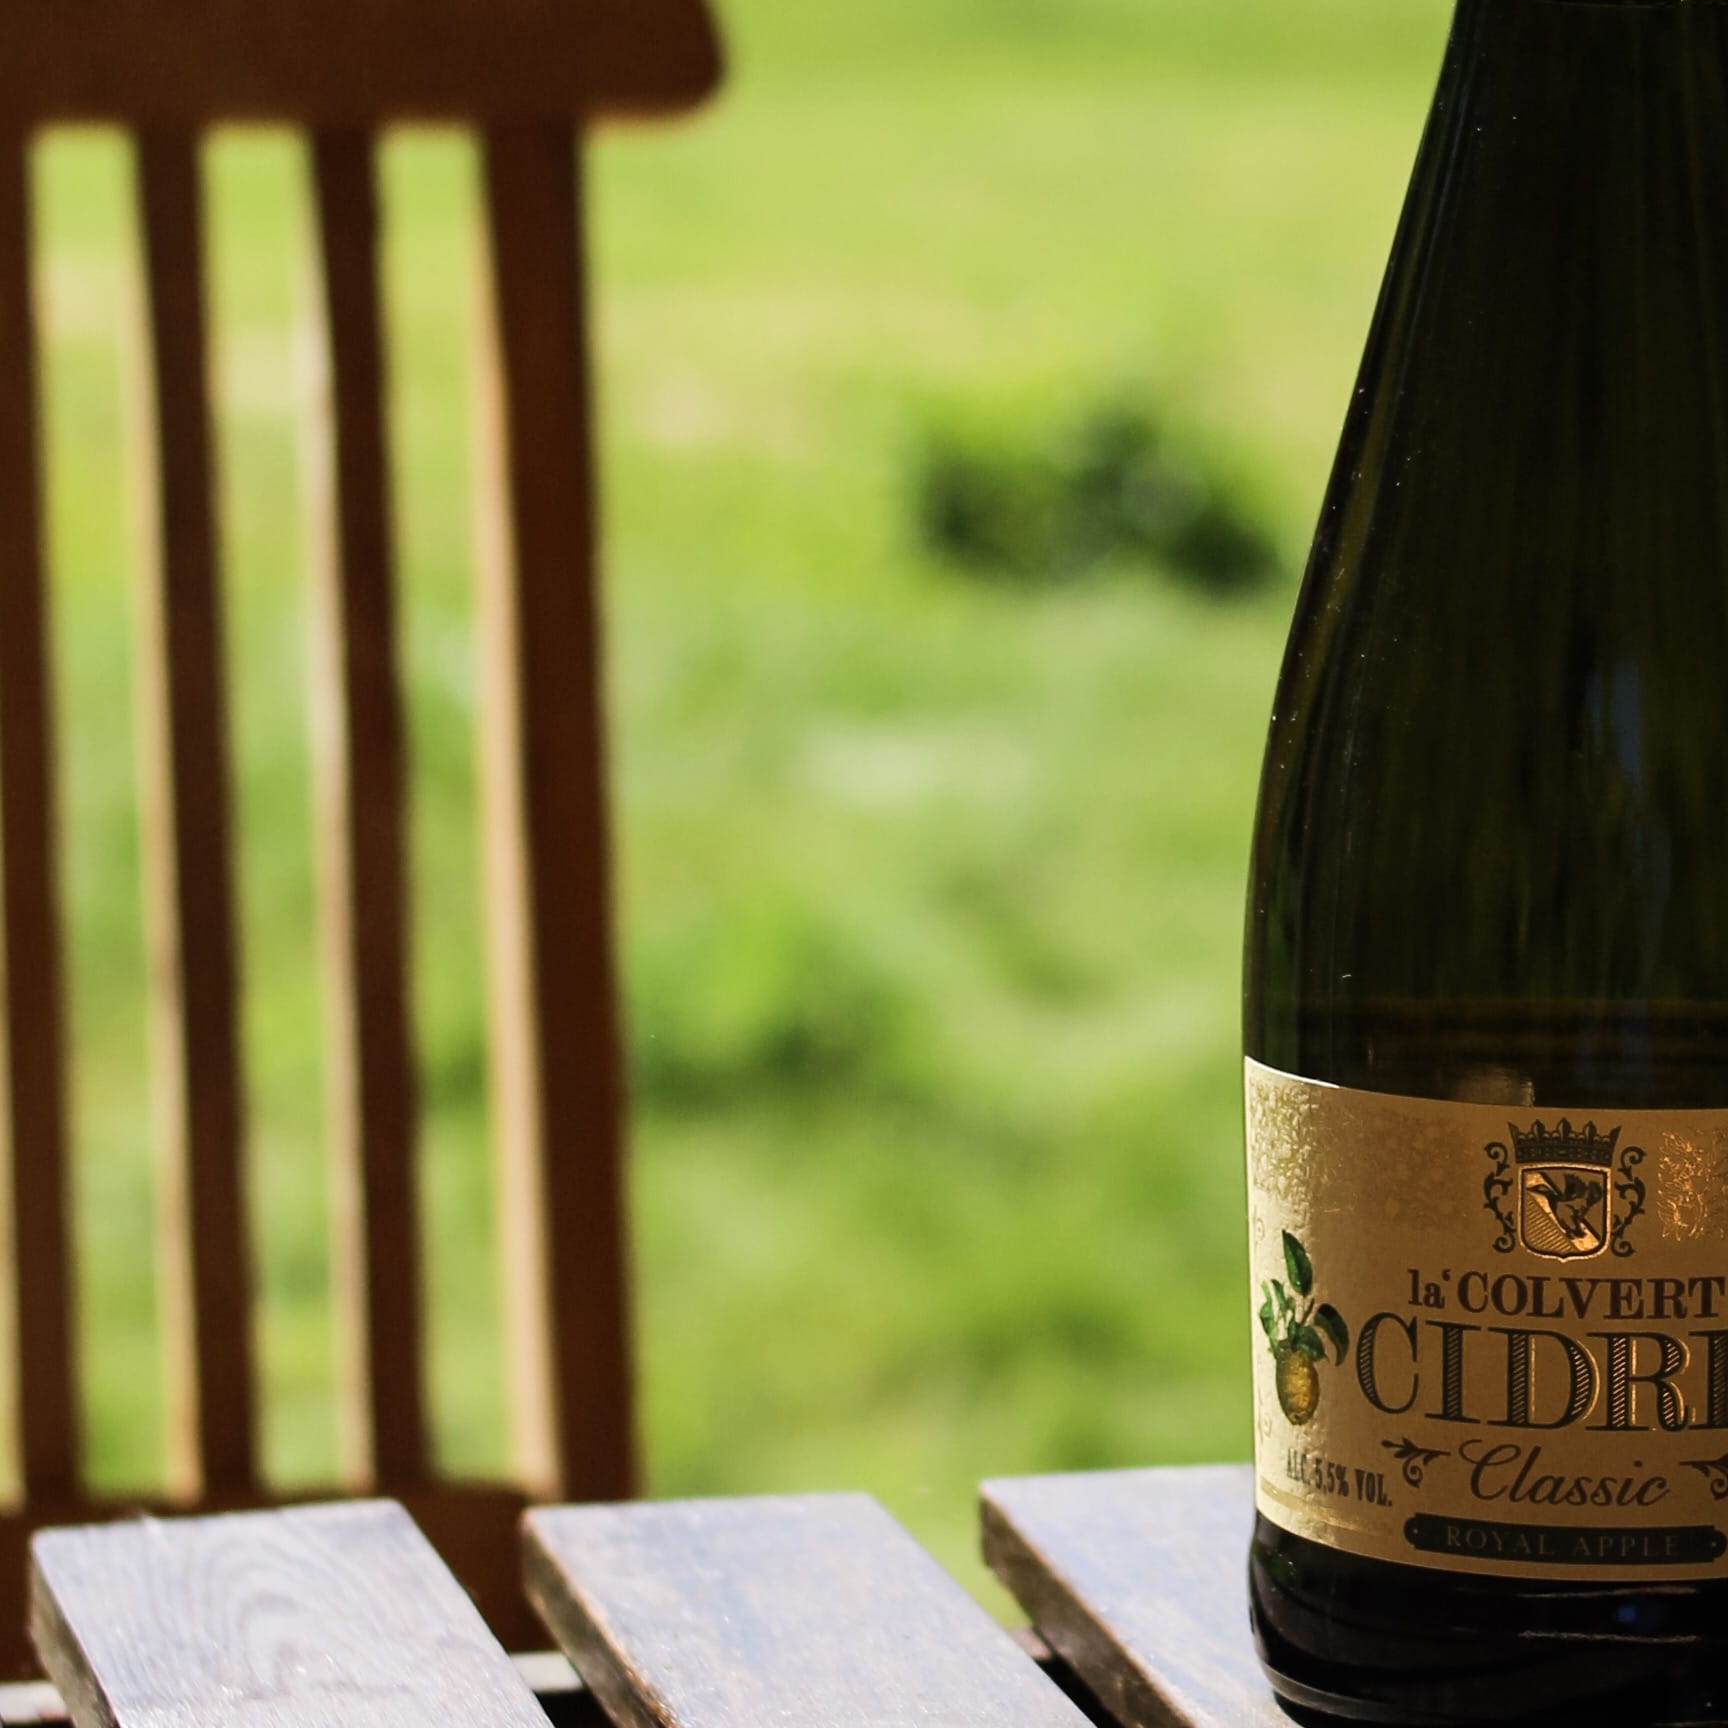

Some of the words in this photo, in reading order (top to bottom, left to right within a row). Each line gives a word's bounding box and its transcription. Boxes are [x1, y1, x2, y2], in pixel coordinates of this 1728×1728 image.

[1354, 1468, 1393, 1507] VOL.
[1459, 1438, 1670, 1507] Classic
[1446, 1524, 1556, 1556] ROYAL
[1571, 1534, 1681, 1558] APPLE
